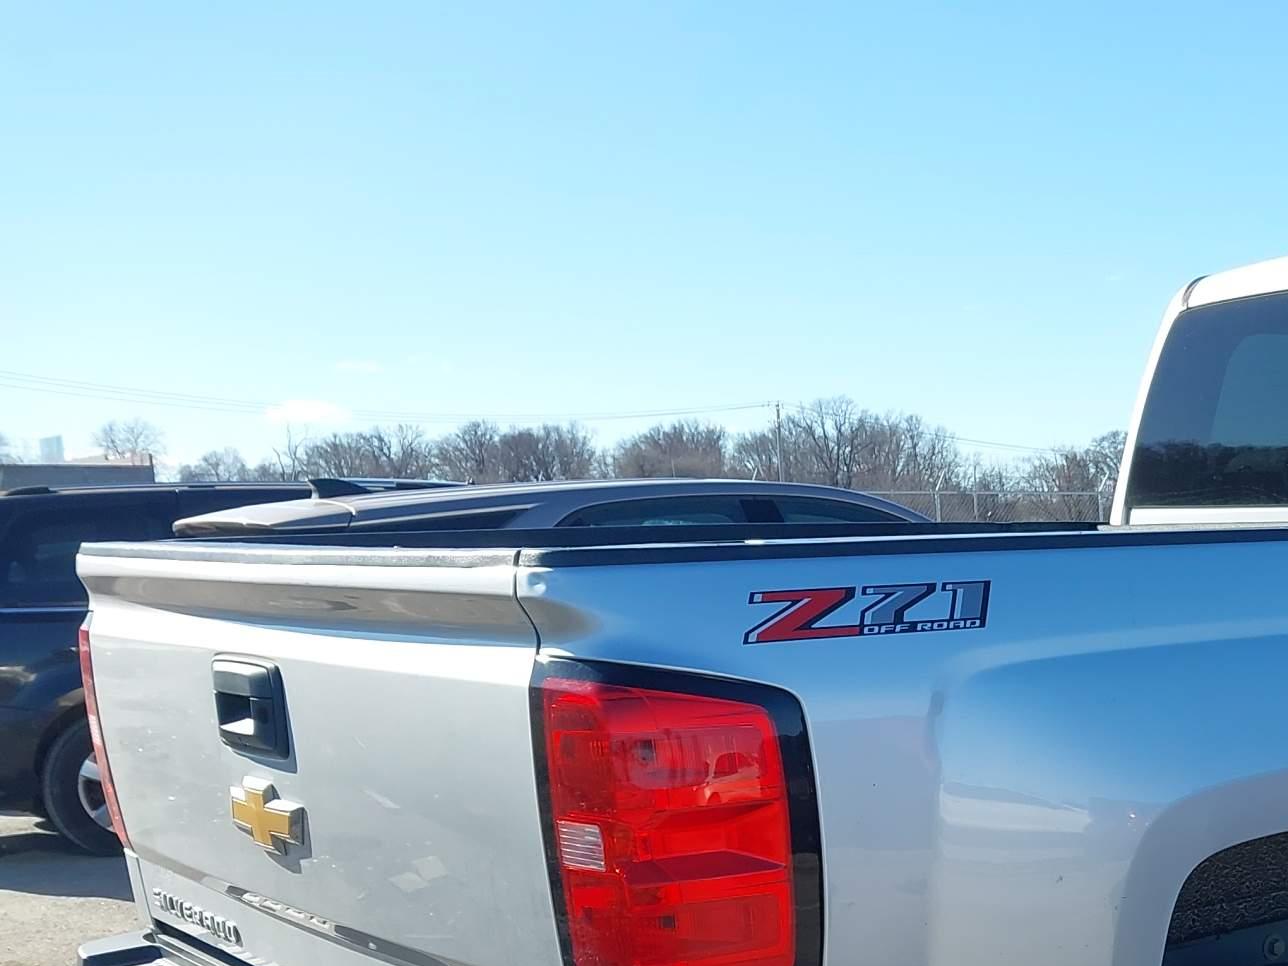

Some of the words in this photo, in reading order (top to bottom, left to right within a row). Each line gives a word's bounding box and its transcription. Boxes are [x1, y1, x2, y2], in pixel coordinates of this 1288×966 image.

[742, 579, 992, 645] Z71
[862, 622, 910, 635] OFF
[916, 618, 981, 631] ROAD
